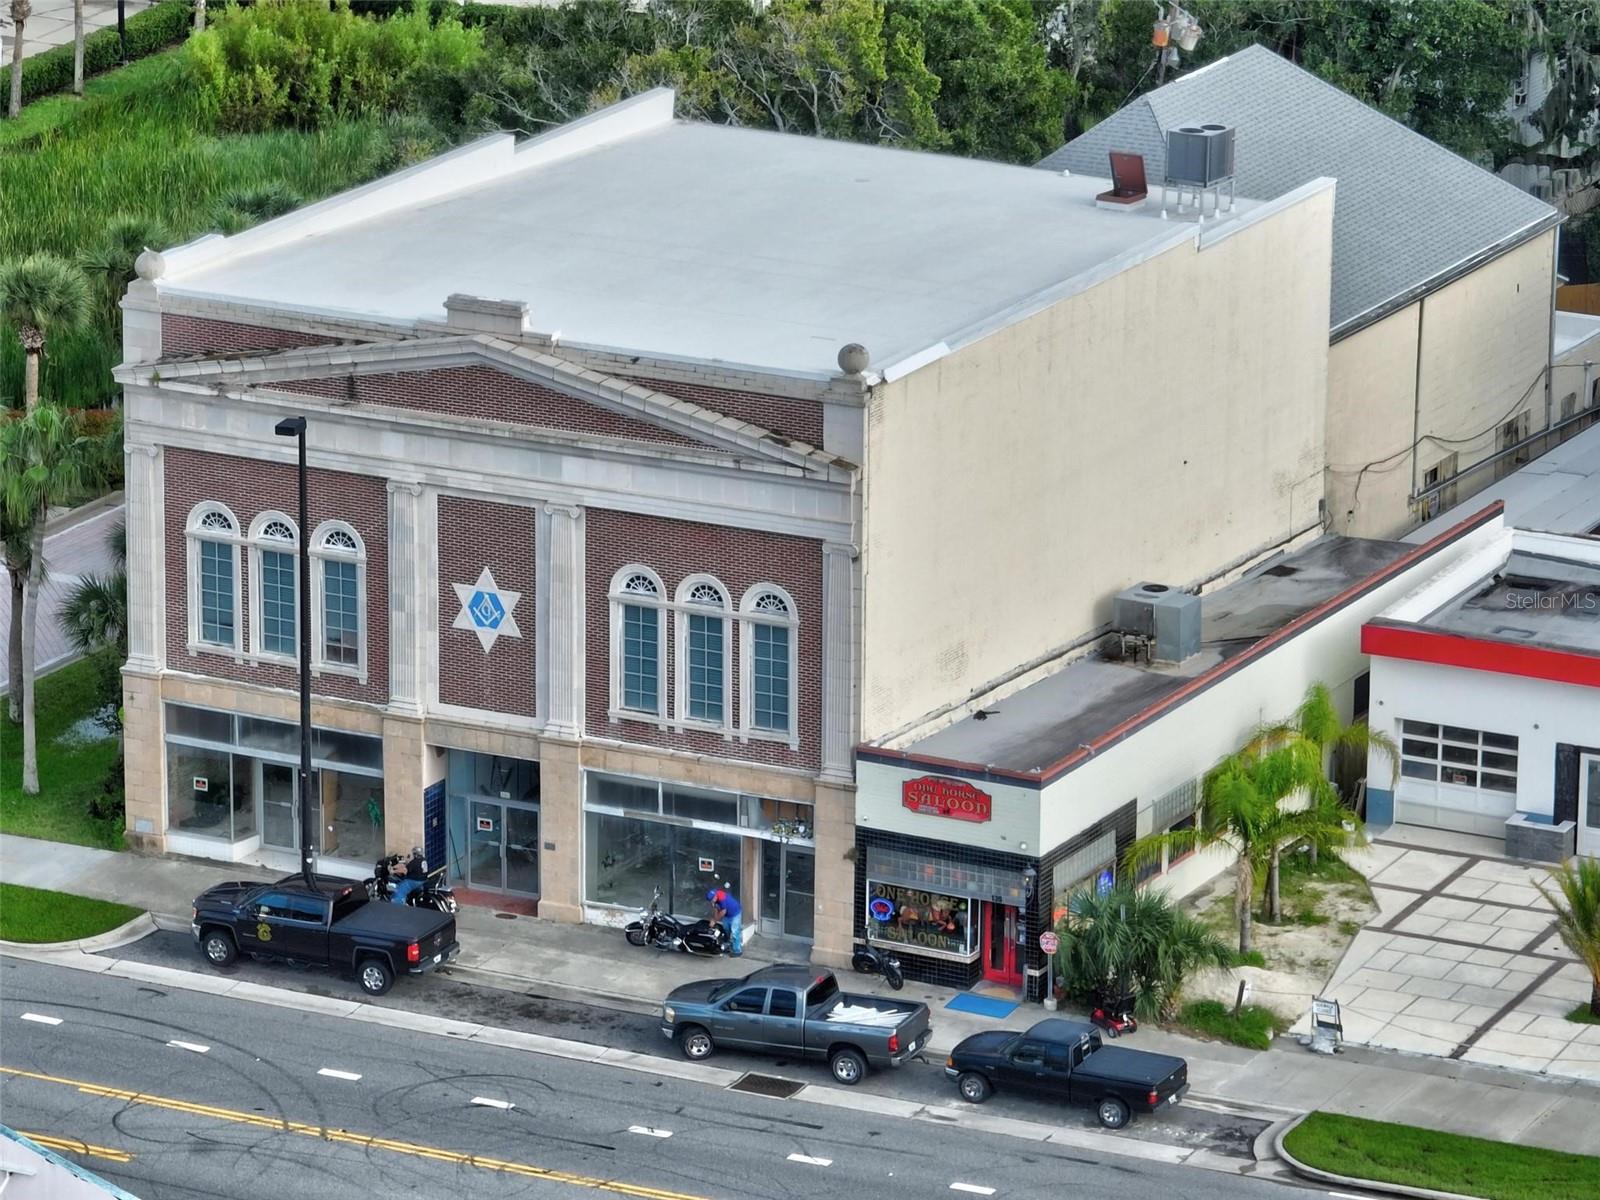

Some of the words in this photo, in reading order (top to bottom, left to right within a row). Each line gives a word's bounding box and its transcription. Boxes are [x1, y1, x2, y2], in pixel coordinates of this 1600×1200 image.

[907, 791, 987, 814] SALOON
[876, 885, 905, 902] ONE
[887, 926, 948, 948] SALOON
